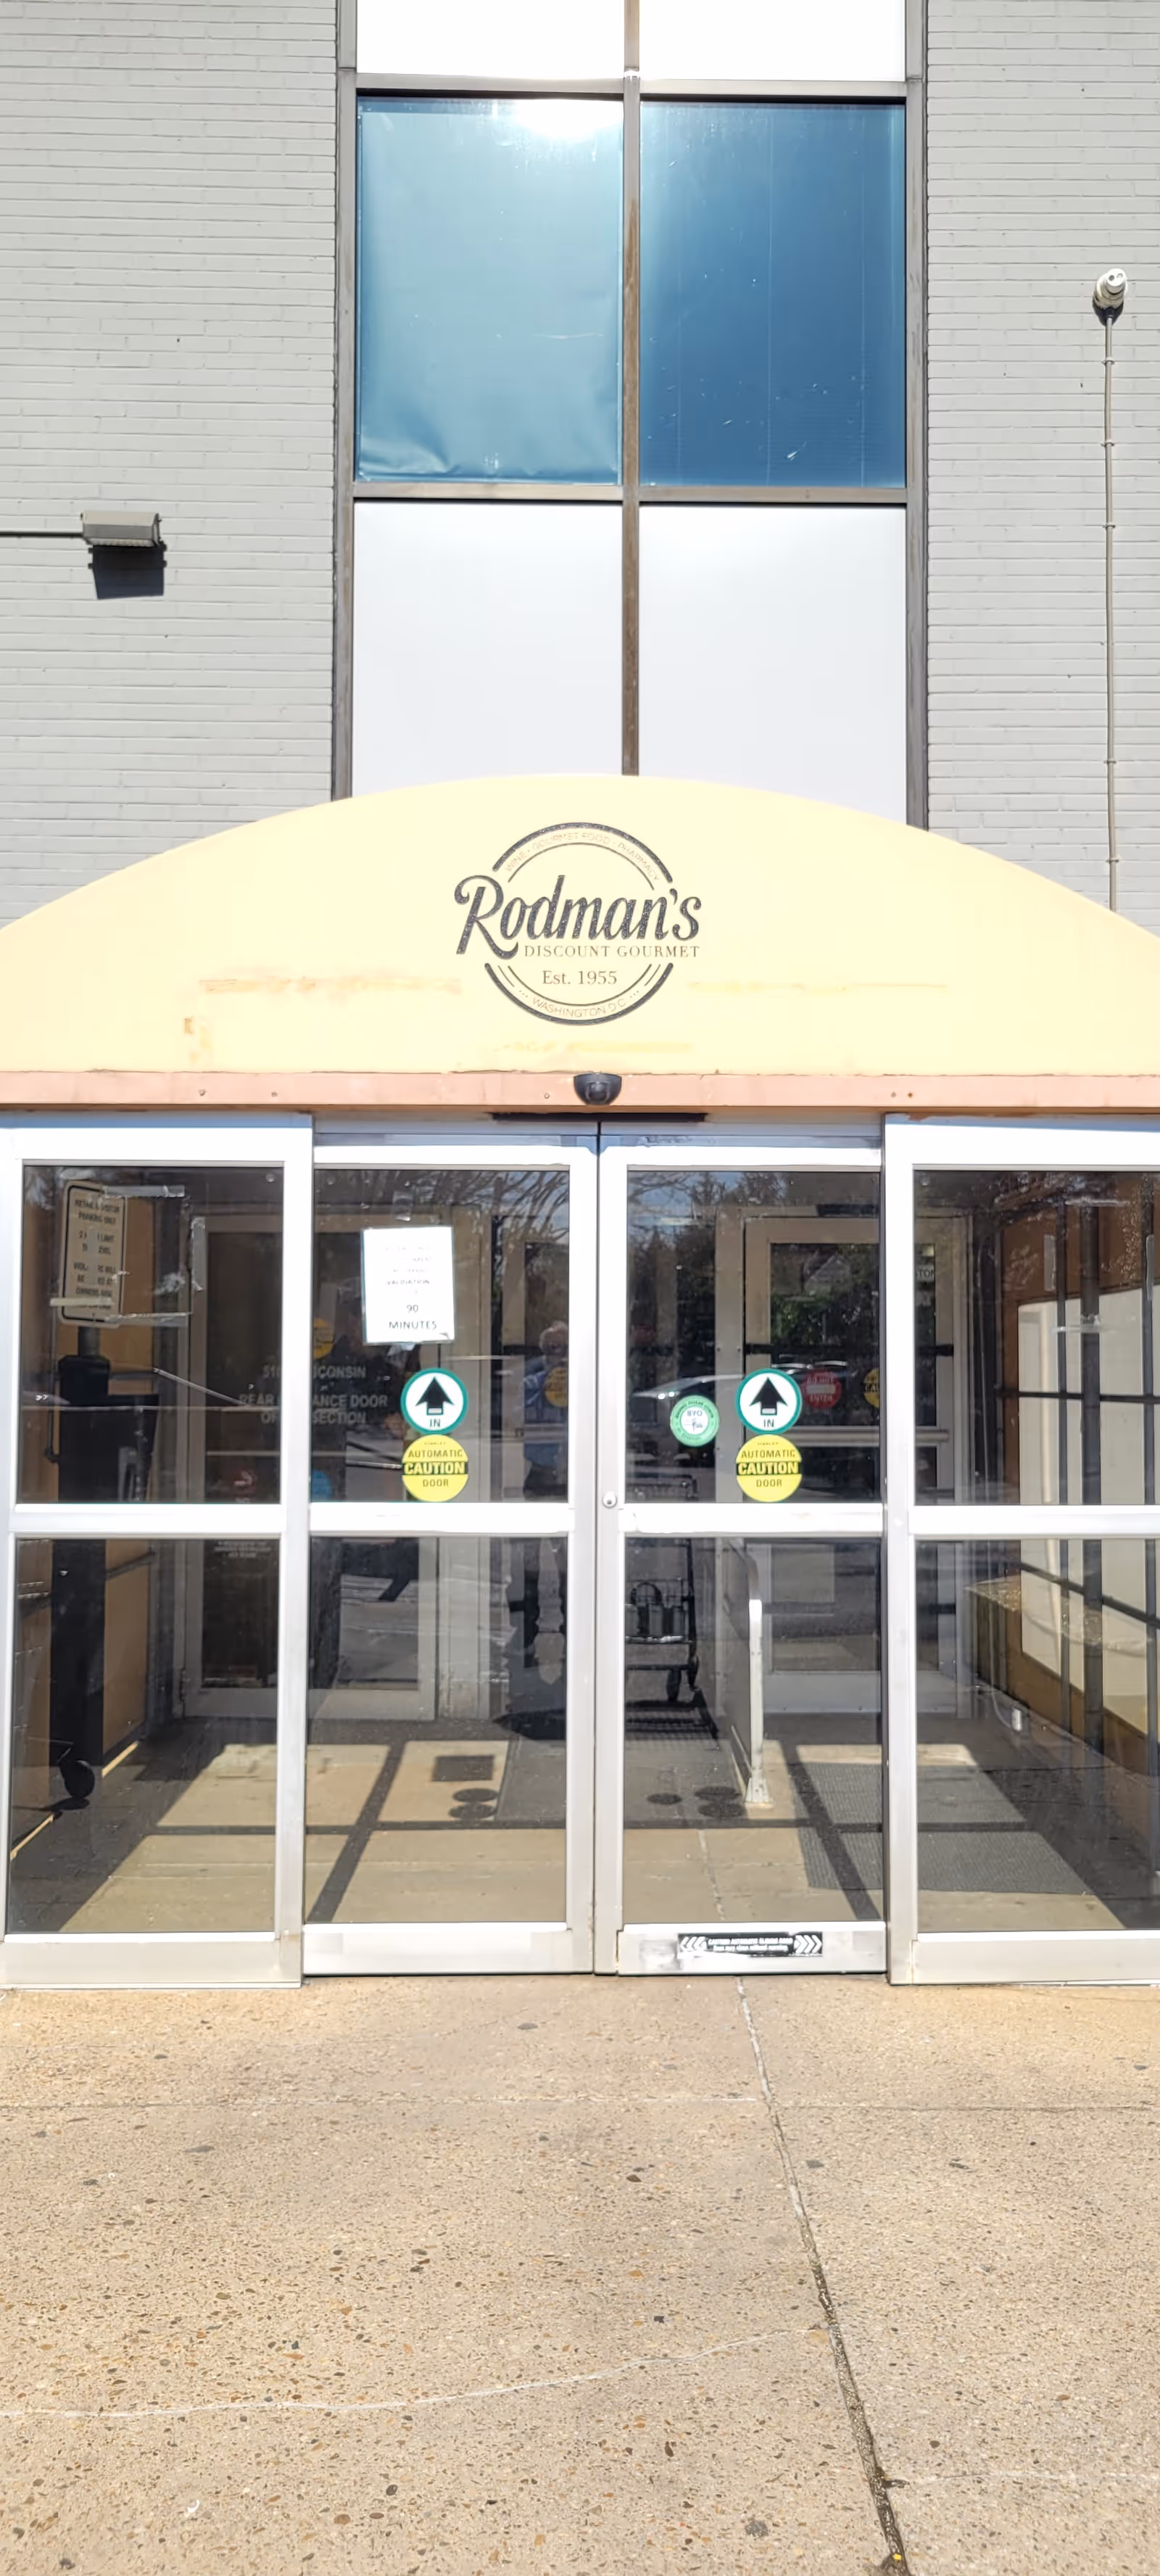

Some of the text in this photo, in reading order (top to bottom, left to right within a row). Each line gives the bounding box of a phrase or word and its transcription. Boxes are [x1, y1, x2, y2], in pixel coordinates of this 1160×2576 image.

[617, 843, 660, 882] PHARMACY
[454, 875, 702, 960] Rodman's
[524, 945, 700, 958] DISCOUNT GOURMET
[542, 970, 618, 986] Est. 1955
[532, 997, 607, 1017] WASHINGTON
[406, 1304, 419, 1313] 90
[389, 1321, 437, 1331] MINUTES
[351, 1395, 389, 1407] DOOR
[429, 1418, 441, 1428] IN
[763, 1419, 774, 1428] IN
[408, 1449, 463, 1458] AUTOMATIC
[741, 1449, 795, 1459] AUTOMATIC
[404, 1461, 465, 1475] CAUTION
[737, 1461, 799, 1475] CAUTION
[423, 1479, 449, 1487] DOOR
[756, 1479, 782, 1487] DOOR
